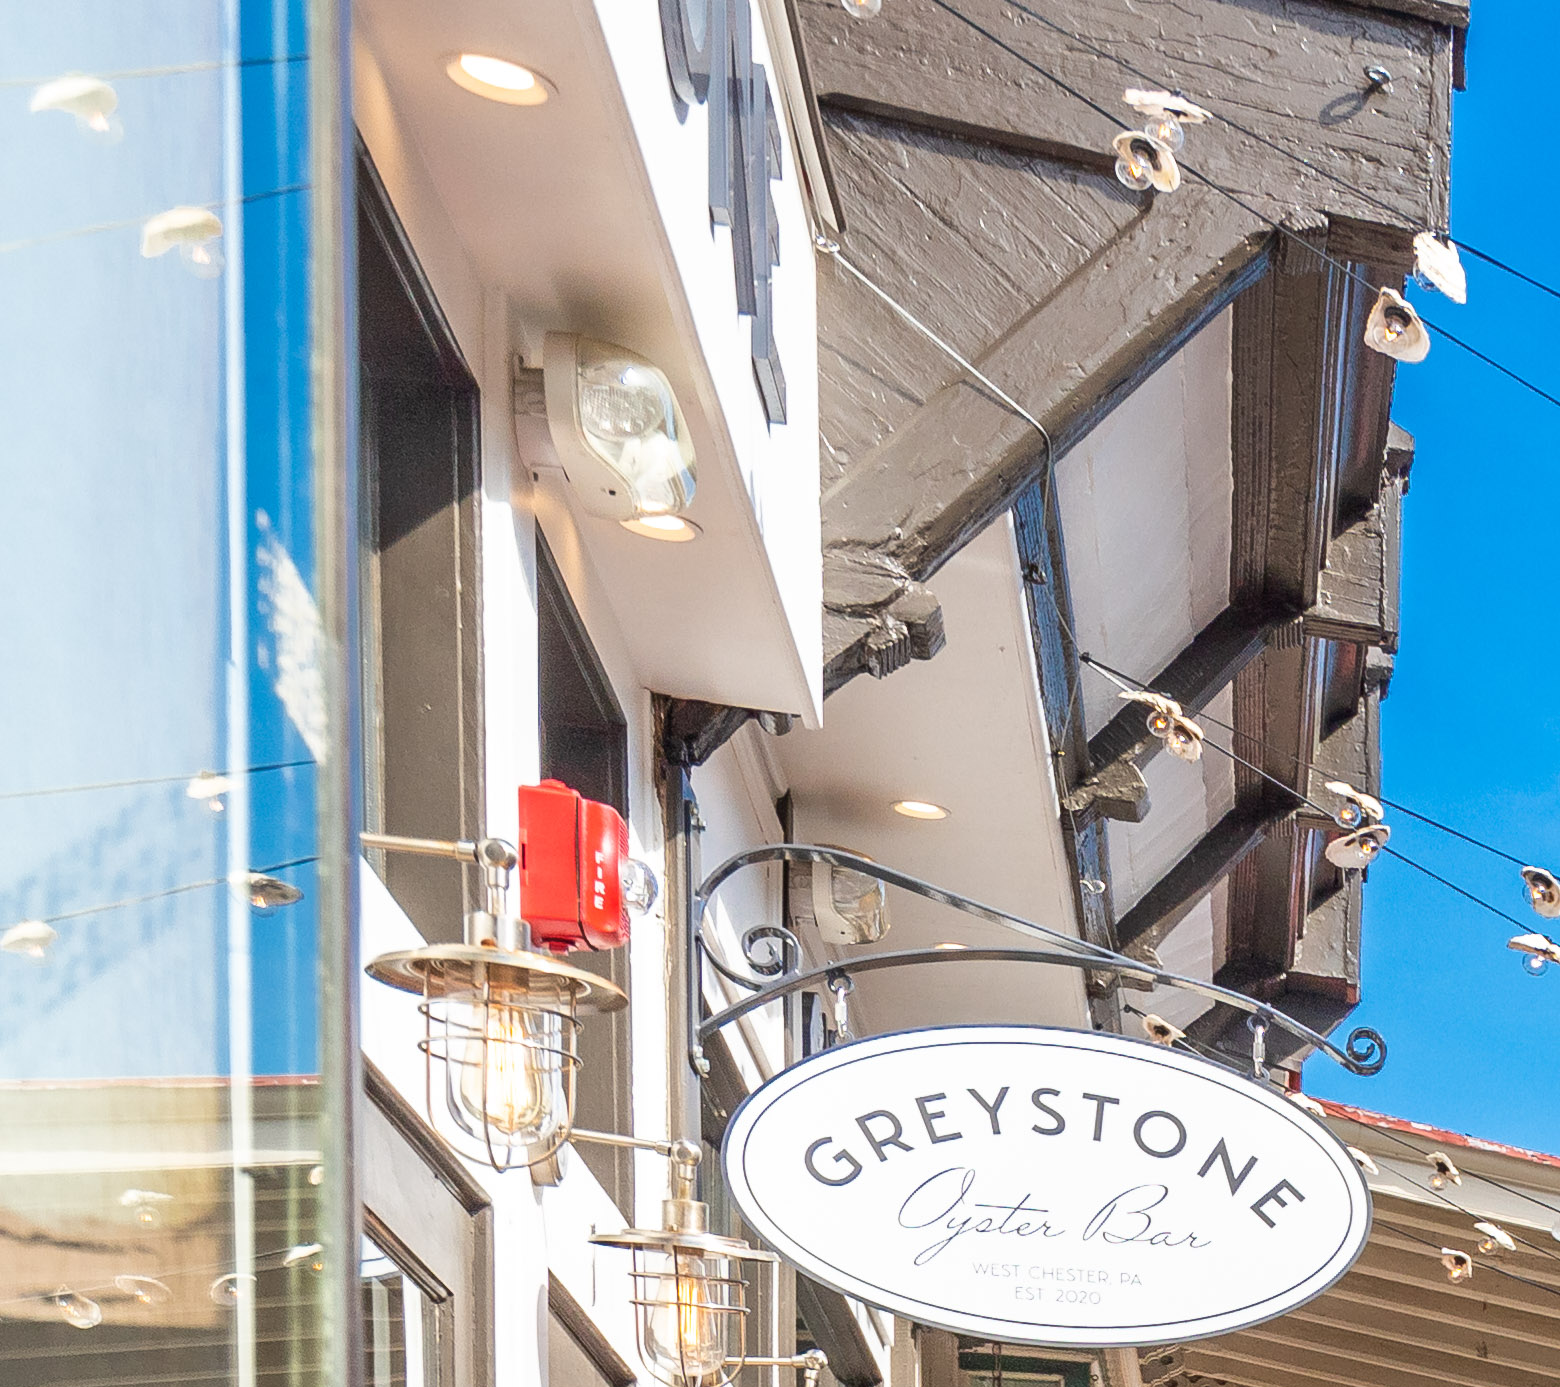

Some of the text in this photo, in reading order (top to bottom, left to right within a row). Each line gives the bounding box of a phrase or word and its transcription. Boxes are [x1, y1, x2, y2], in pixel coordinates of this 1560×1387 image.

[594, 850, 606, 910] FIRE
[804, 1085, 1306, 1229] GREYSTONE
[897, 1166, 1212, 1266] Oyster Bar
[972, 1262, 1020, 1278] WEST
[1120, 1272, 1142, 1286] PA
[1055, 1289, 1101, 1305] 2020
